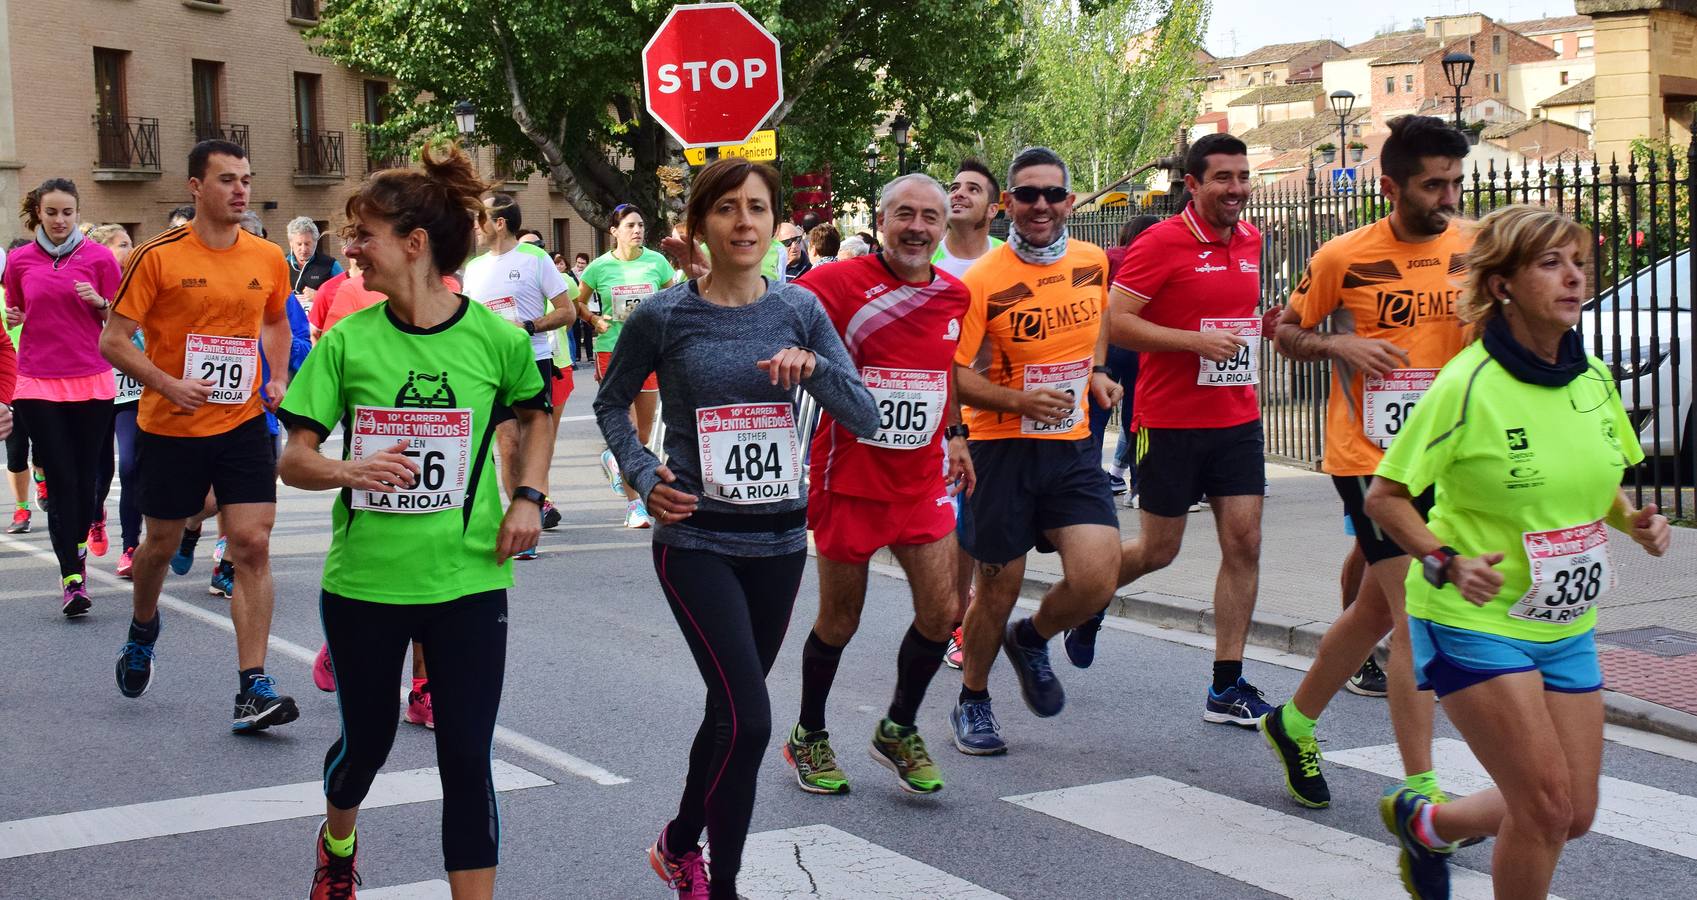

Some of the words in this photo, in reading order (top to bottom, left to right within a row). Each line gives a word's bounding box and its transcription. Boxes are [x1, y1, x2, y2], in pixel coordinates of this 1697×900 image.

[658, 58, 767, 94] STOP
[740, 146, 773, 158] Cenicero
[1046, 298, 1098, 330] EMESA
[203, 344, 224, 354] ENTRE
[226, 346, 251, 355] VIÑEDOS
[116, 374, 144, 390] 70
[201, 362, 242, 389] 219
[881, 378, 906, 388] ENTRE
[1210, 374, 1223, 382] LA
[1226, 374, 1252, 382] RIOJA
[1385, 381, 1412, 390] ENTRE
[212, 390, 243, 400] RIOJA
[403, 414, 447, 422] CARRERA
[744, 407, 778, 416] CARRERA
[879, 400, 927, 431] 305
[376, 423, 411, 434] ENTRE
[412, 422, 460, 436] VIÑEDOS
[460, 414, 468, 436] 2017
[722, 418, 751, 430] ENTRE
[752, 415, 786, 428] VIÑEDOS
[1034, 421, 1050, 430] LA
[1054, 418, 1074, 430] RIO
[460, 439, 467, 448] 22
[737, 432, 767, 442] ESTHER
[894, 434, 927, 444] RIOJA
[702, 435, 713, 482] CENICERO
[725, 442, 783, 481] 484
[790, 441, 799, 479] OCTUBRE
[381, 450, 445, 490] 56
[456, 451, 466, 487] OCTUBRE
[720, 486, 742, 499] LA
[747, 483, 789, 499] RIOJA
[369, 493, 391, 507] LA
[398, 493, 451, 508] RIOJA
[1545, 562, 1602, 606] 338
[1528, 608, 1552, 619] LA
